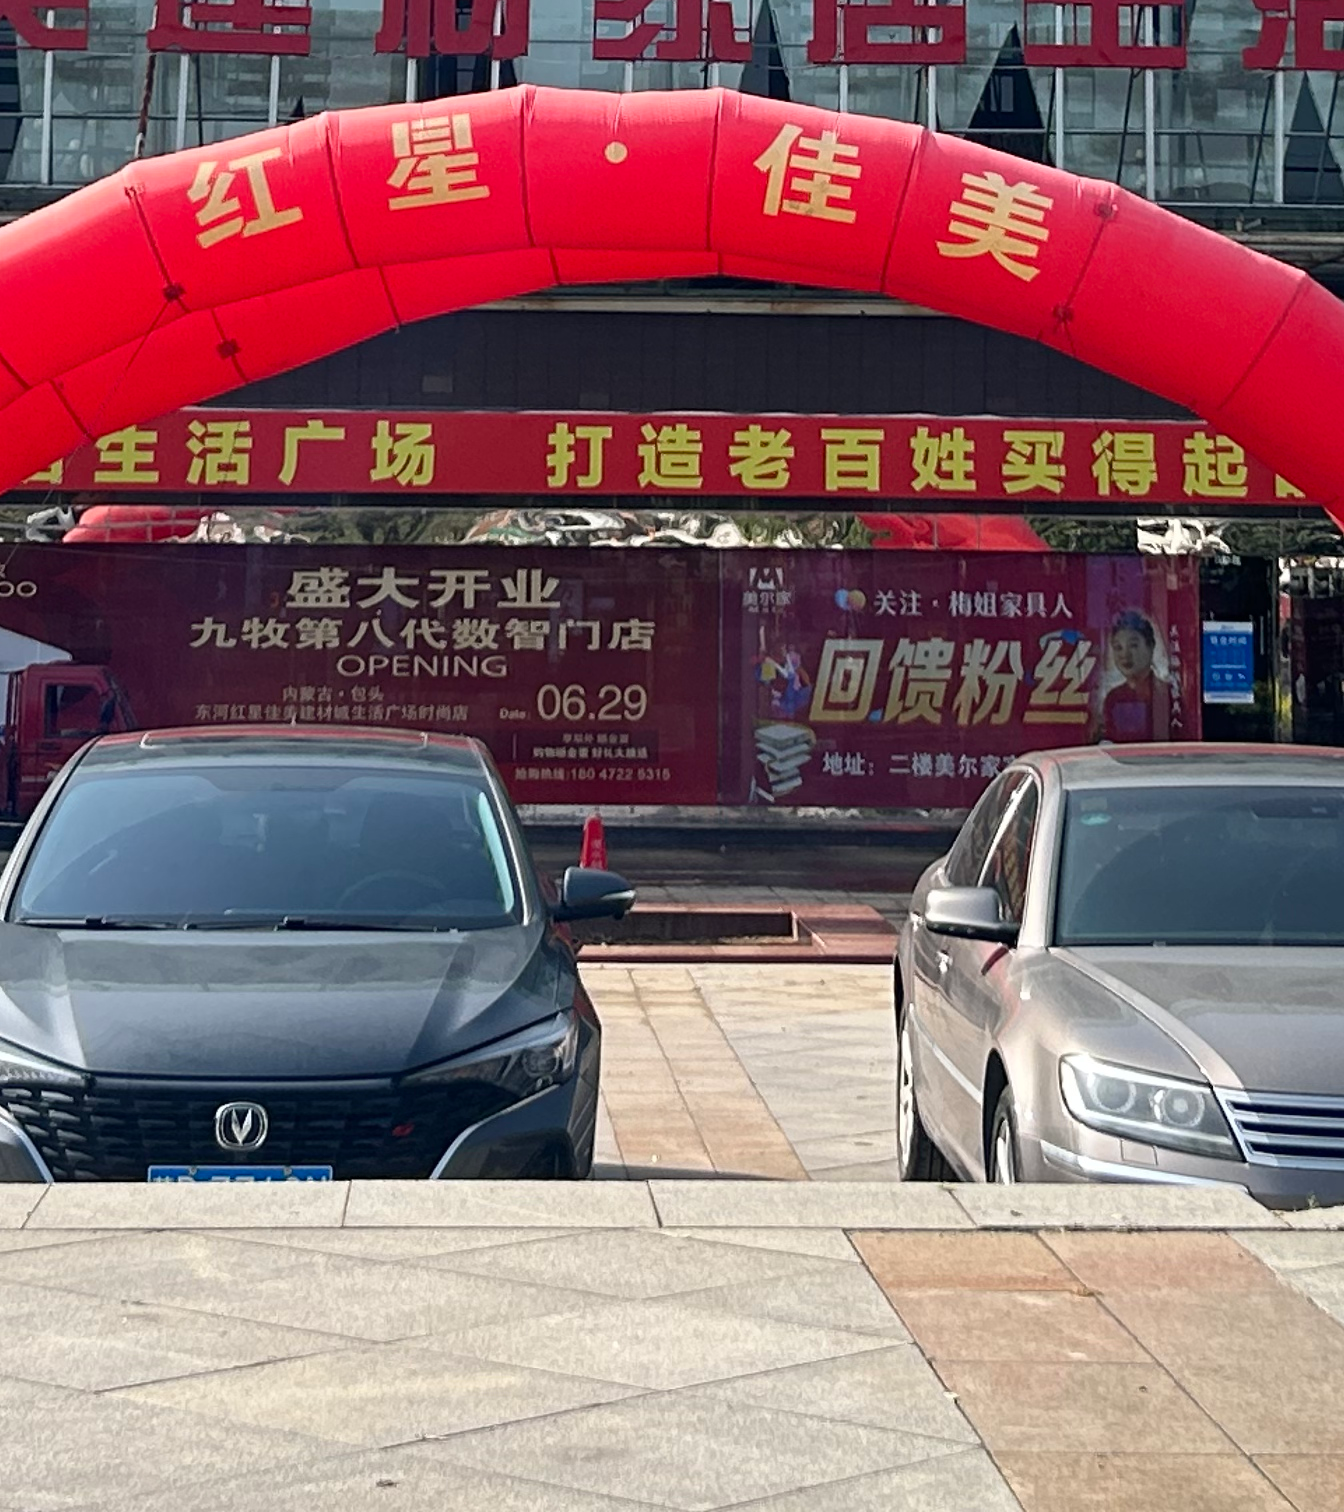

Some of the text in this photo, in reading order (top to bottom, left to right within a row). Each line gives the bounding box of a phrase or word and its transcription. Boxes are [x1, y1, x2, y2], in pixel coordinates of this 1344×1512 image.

[285, 567, 561, 610] 盛大开业
[189, 617, 657, 652] 九牧第八代数智门店
[336, 654, 508, 678] OPENING
[809, 636, 1097, 726] 回馈粉丝
[537, 683, 648, 722] 06.29
